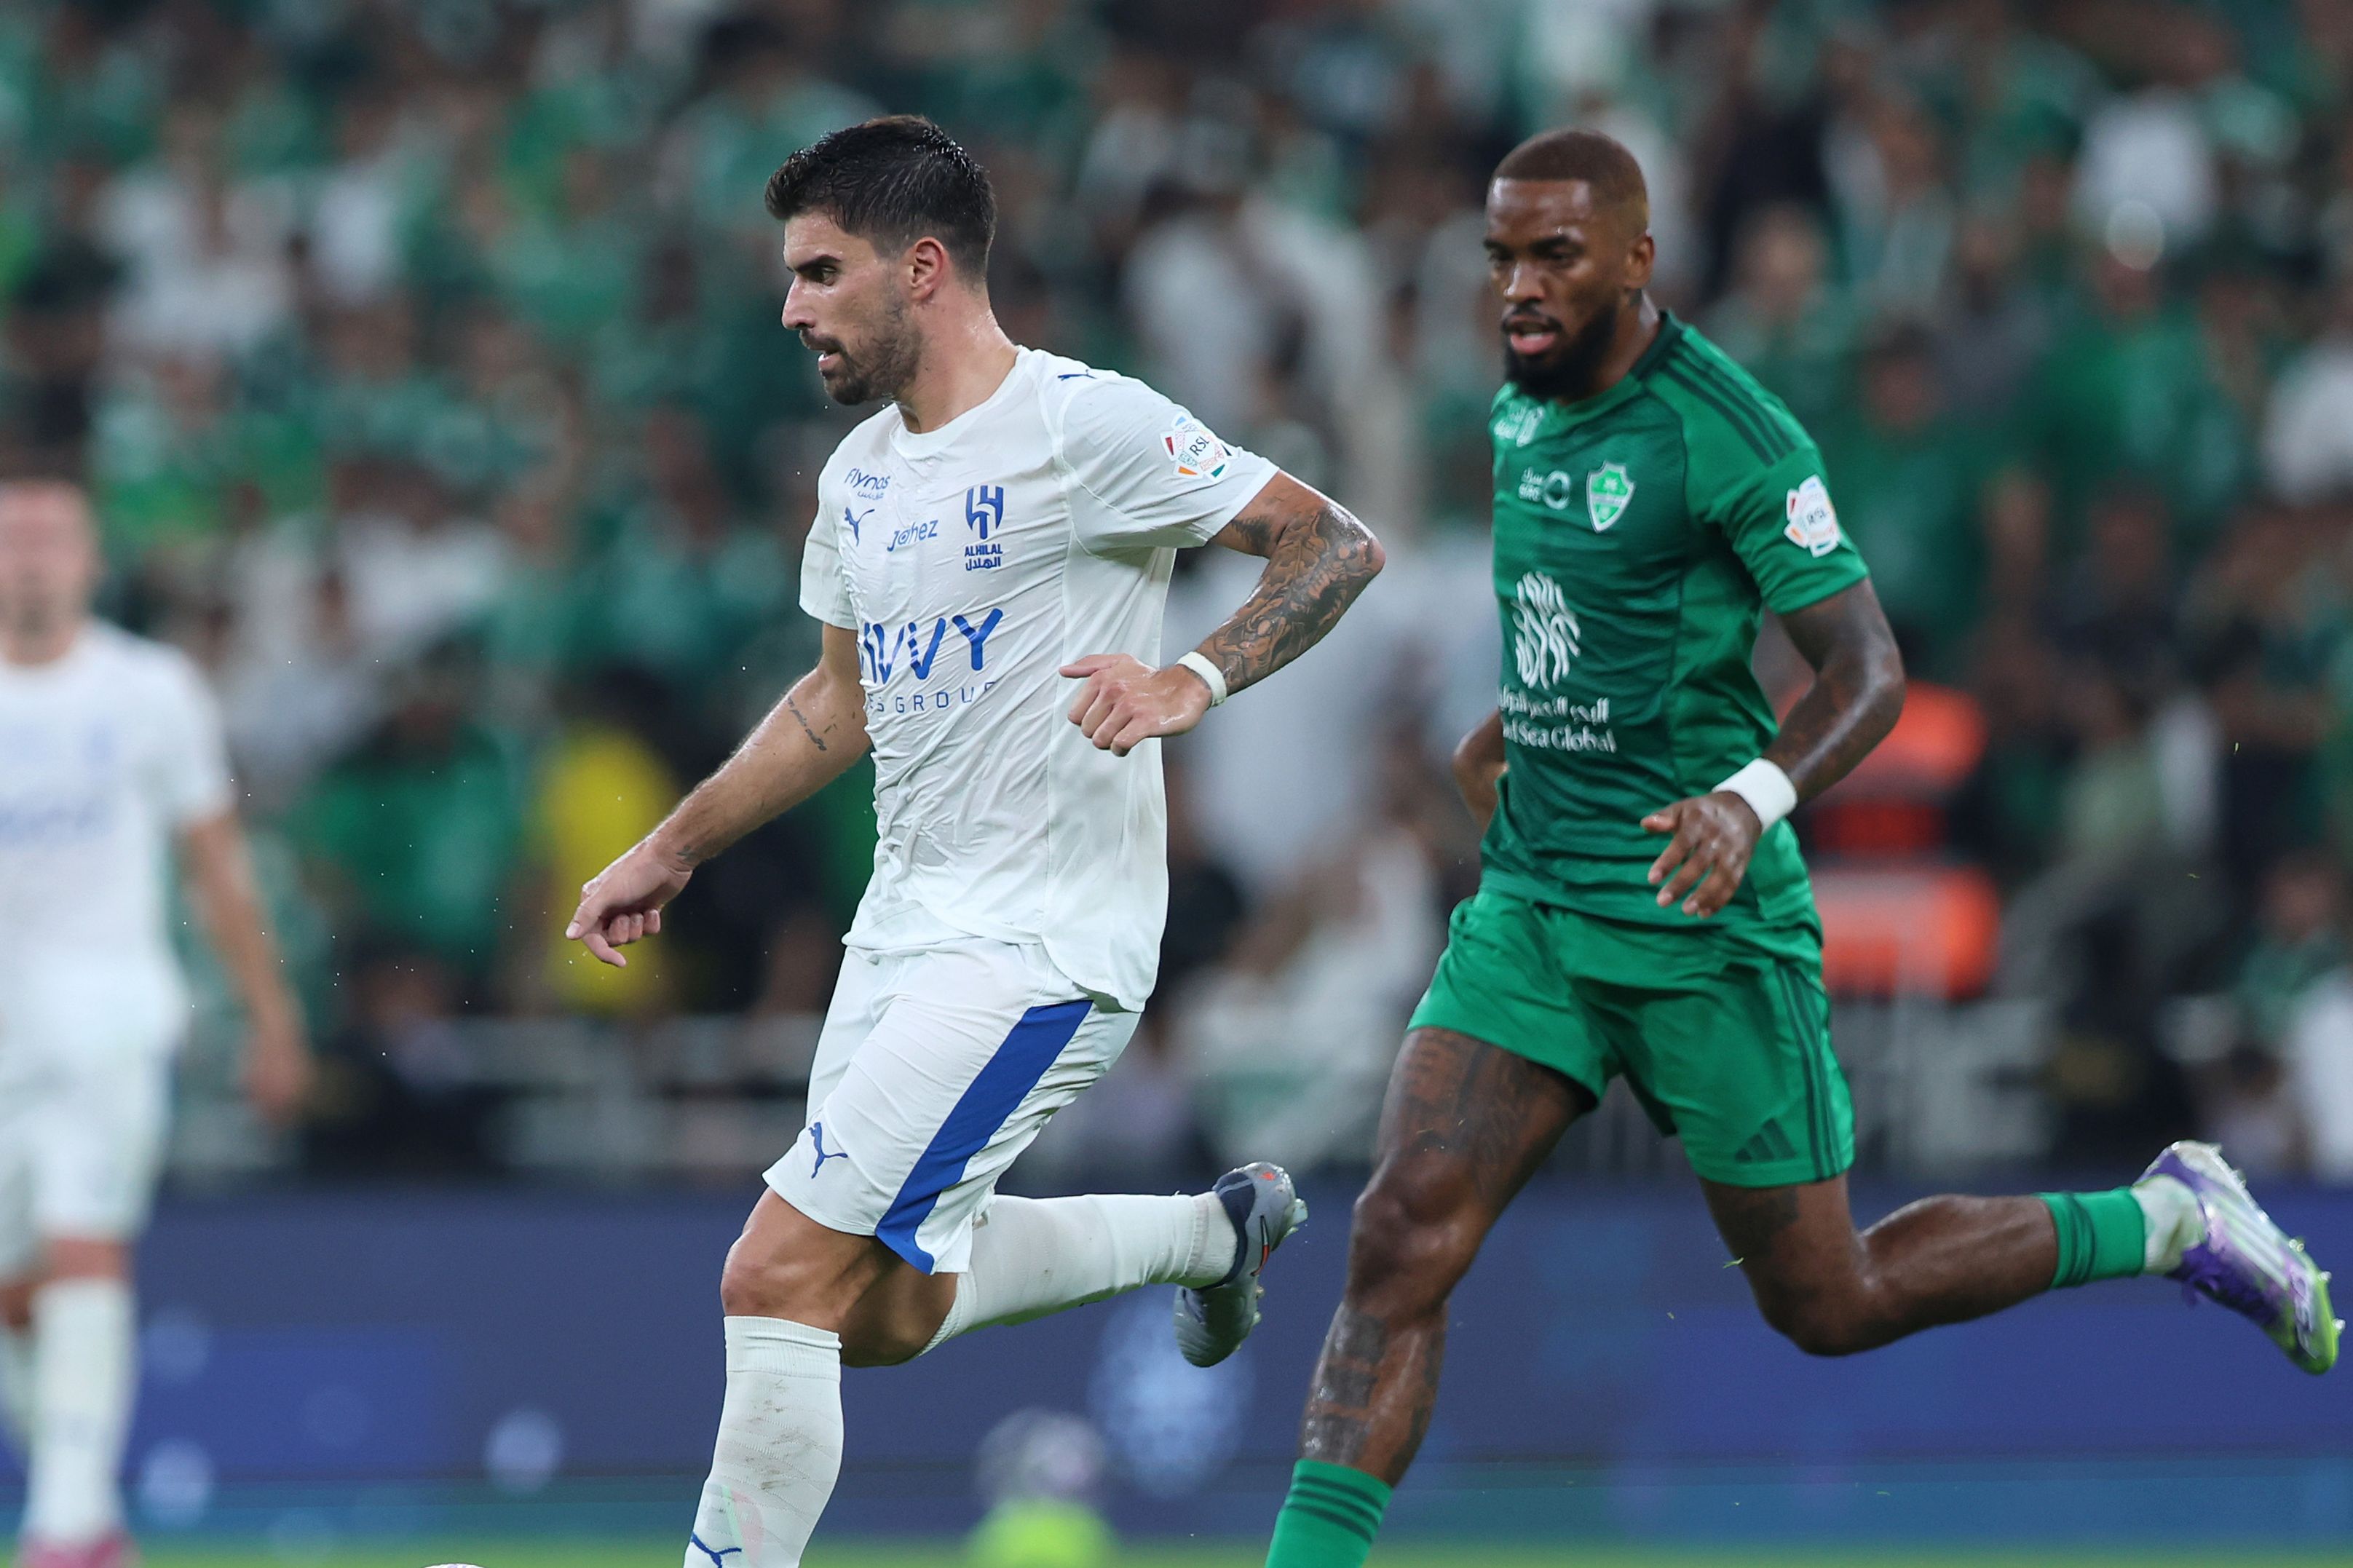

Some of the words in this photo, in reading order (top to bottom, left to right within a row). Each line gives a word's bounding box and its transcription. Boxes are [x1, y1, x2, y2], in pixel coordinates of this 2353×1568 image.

[1189, 436, 1209, 456] RSL
[1519, 720, 1550, 748] Sea
[1551, 724, 1618, 753] Global
